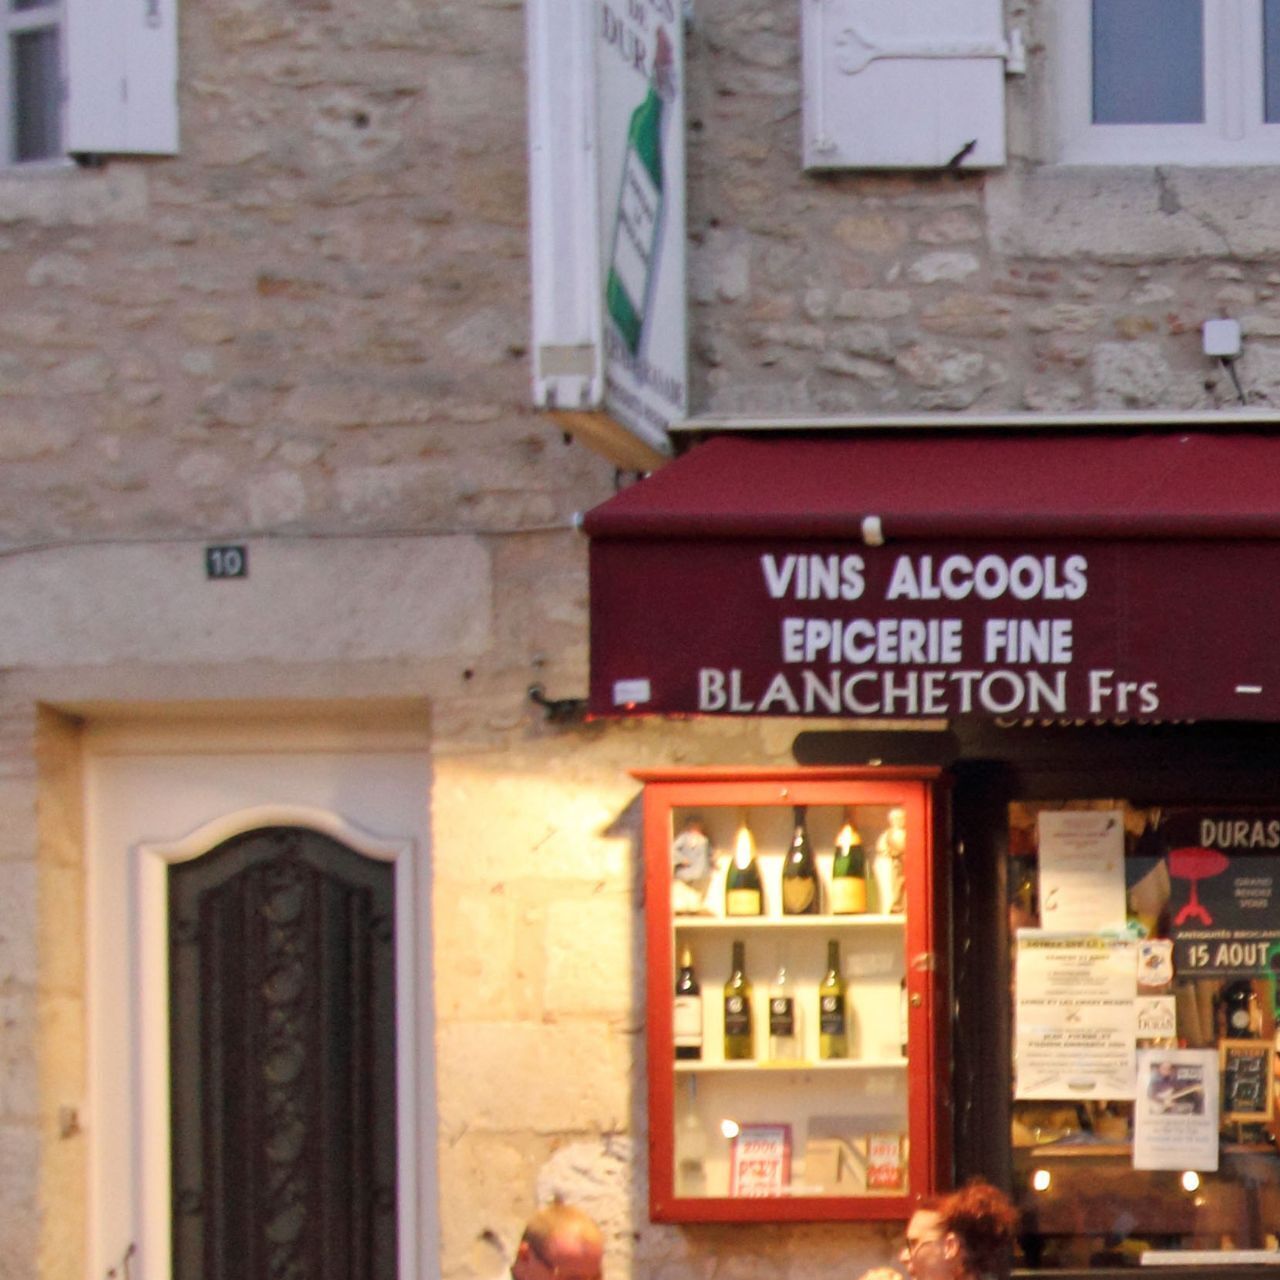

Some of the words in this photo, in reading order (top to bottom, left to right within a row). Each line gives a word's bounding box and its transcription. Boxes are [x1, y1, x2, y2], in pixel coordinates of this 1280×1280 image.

[211, 548, 243, 577] 10
[761, 554, 866, 600] VINS
[885, 555, 1089, 601] ALCOOLS
[782, 618, 962, 664] EPICERIE
[984, 618, 1074, 664] FINE
[699, 668, 1067, 715] BLANCHETON
[1088, 669, 1160, 714] Frs
[1201, 818, 1280, 849] DURAS
[1188, 943, 1210, 967] 15
[1214, 941, 1272, 967] AOUT
